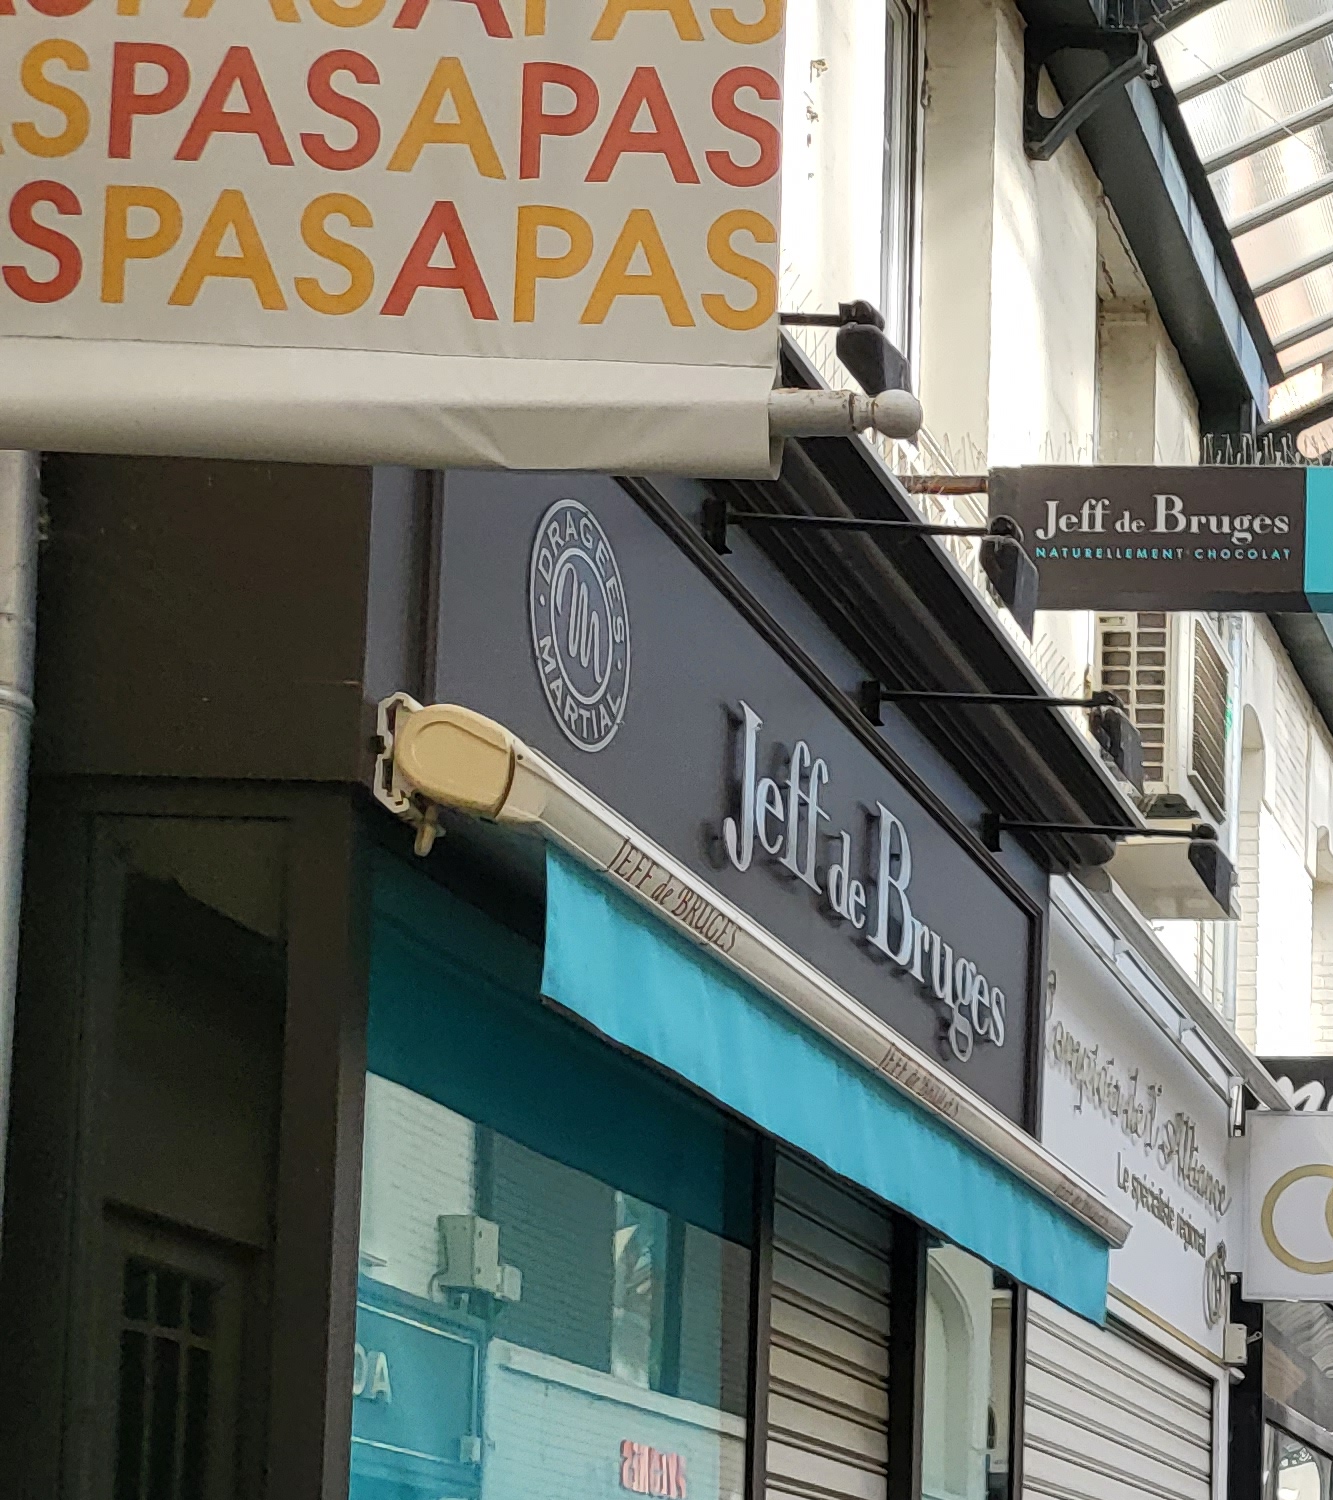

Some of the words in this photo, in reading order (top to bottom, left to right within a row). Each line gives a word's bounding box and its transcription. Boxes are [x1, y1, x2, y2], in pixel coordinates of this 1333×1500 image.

[1035, 498, 1111, 541] Jeff
[1114, 510, 1147, 534] de
[1150, 494, 1290, 545] Bruges
[1035, 547, 1183, 559] NATURELLEMENT
[1194, 548, 1292, 560] CHOCOLAT
[539, 635, 622, 739] MARTIAL
[597, 836, 659, 890] JEFF
[651, 873, 674, 906] de
[671, 884, 742, 954] BRUGES
[723, 700, 831, 895] Jeff
[827, 829, 867, 930] de
[866, 801, 1005, 1062] Bruges
